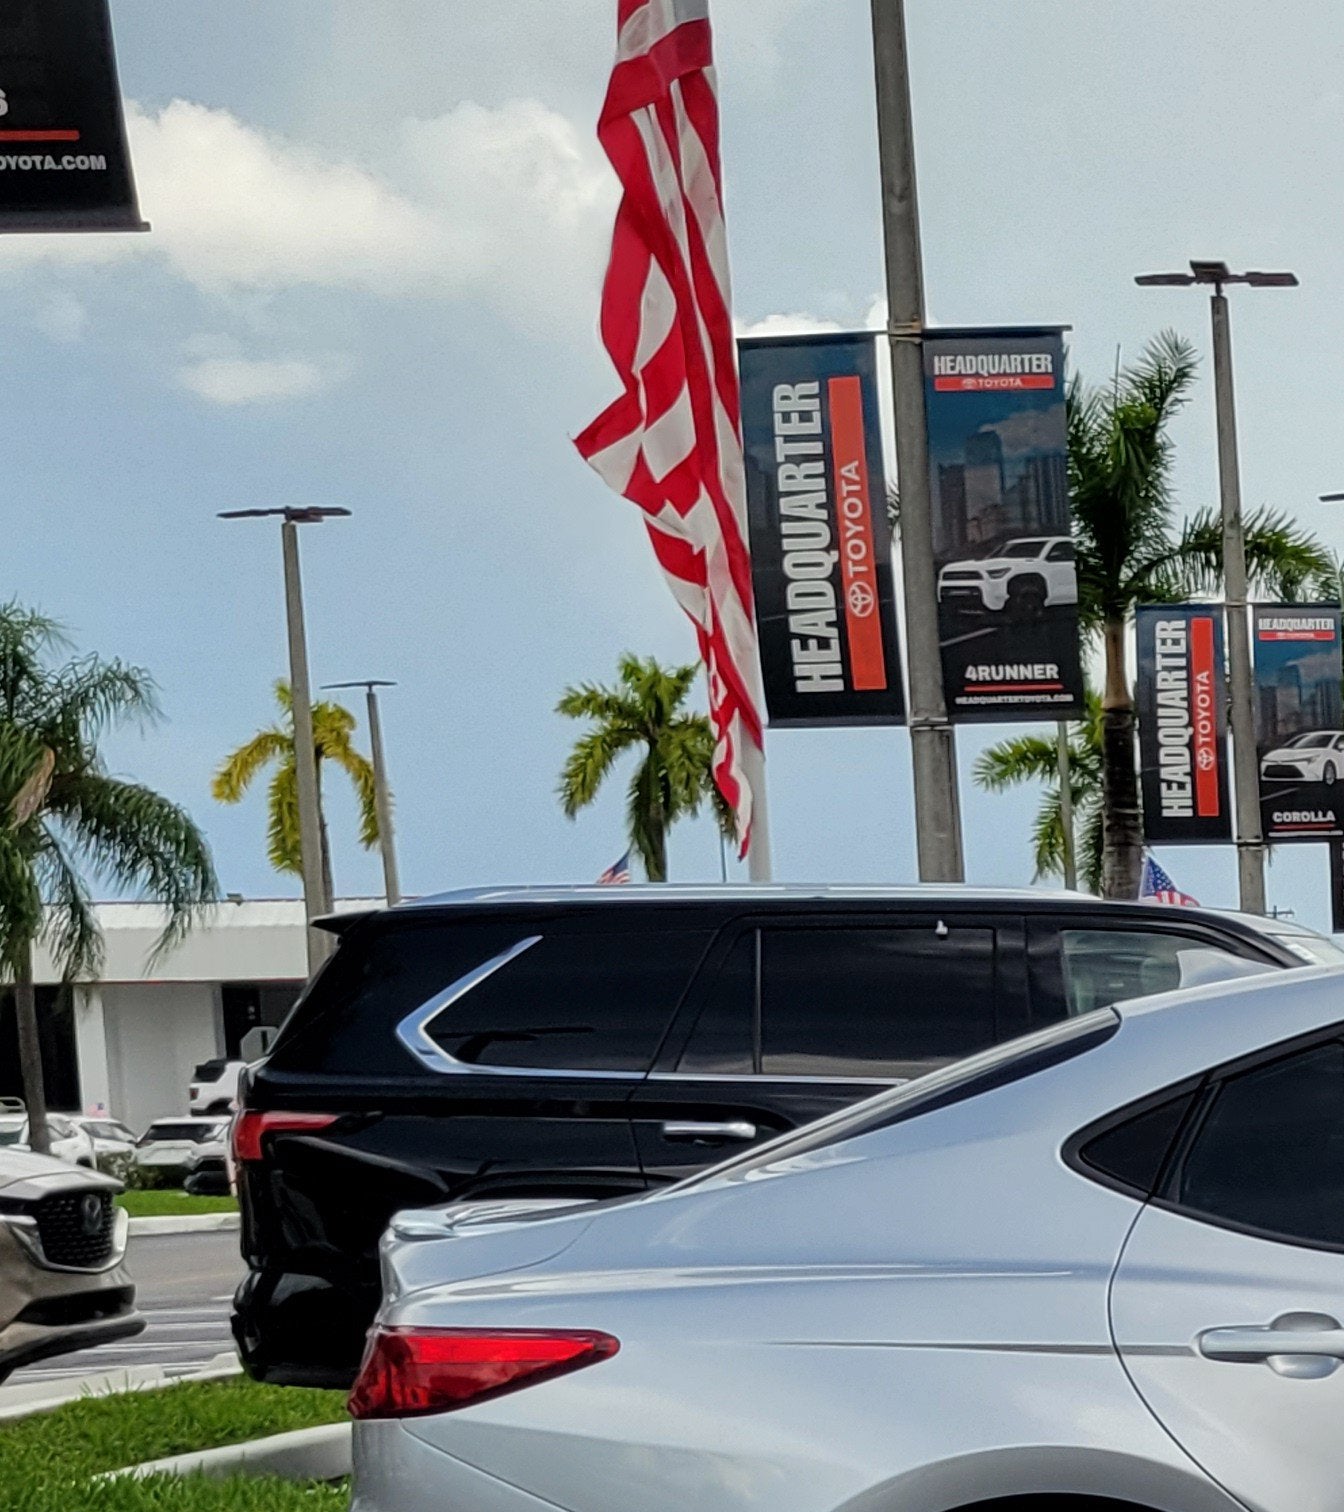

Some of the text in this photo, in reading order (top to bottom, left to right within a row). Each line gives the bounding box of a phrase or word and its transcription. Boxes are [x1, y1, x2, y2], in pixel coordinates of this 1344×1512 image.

[934, 354, 1053, 376] HEADQUARTER
[978, 378, 1022, 388] TOYOTA
[773, 381, 844, 693] HEADQUARTER
[840, 460, 869, 578] TOYOTA
[964, 663, 1060, 681] 4RUNNER
[1155, 619, 1194, 817] HEADQUARTER
[1196, 671, 1212, 742] TOYOTA
[1272, 810, 1336, 823] COROLLA
